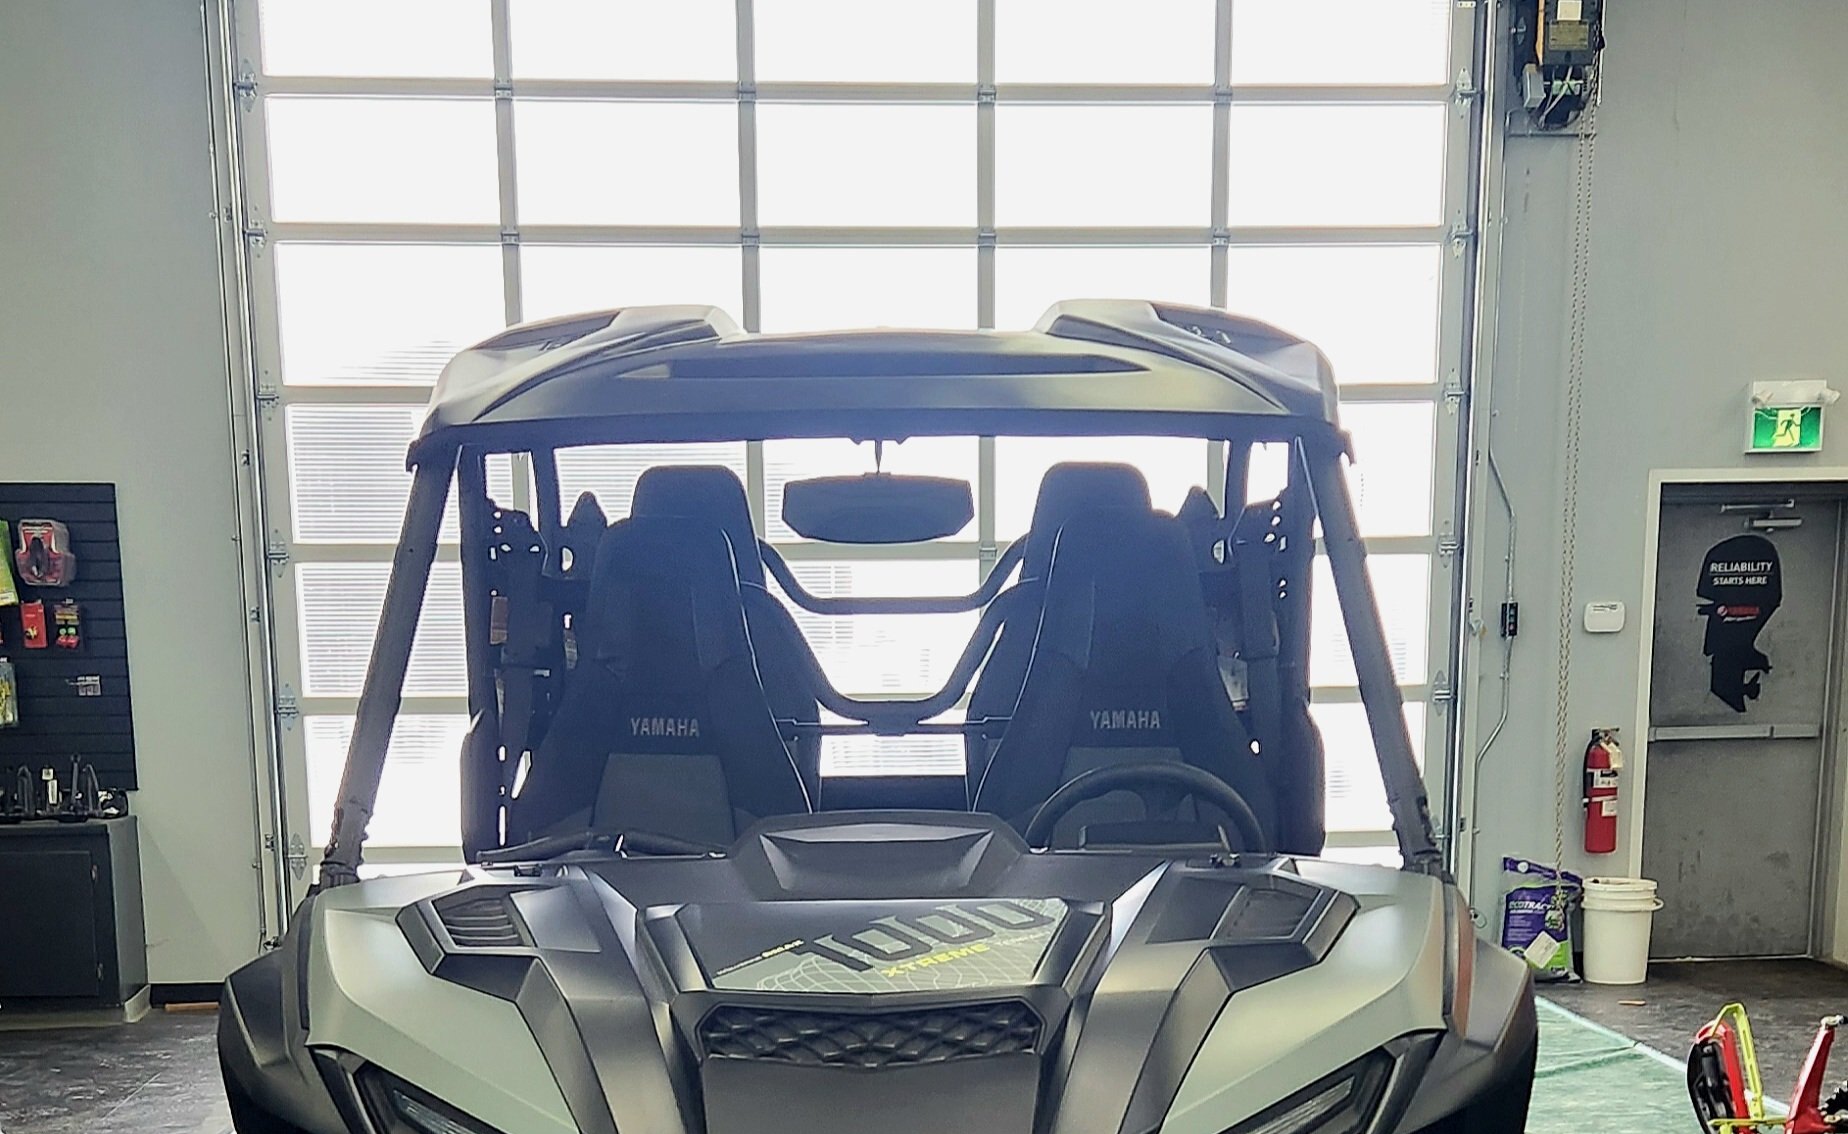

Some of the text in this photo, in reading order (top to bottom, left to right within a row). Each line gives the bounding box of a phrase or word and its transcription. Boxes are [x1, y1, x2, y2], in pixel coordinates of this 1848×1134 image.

[1710, 562, 1773, 572] RELIABILITY
[1713, 576, 1768, 586] STARTS HERE
[630, 717, 700, 737] YAMAHA
[1090, 710, 1161, 729] YAMAHA
[793, 900, 1056, 973] 1000
[881, 943, 991, 977] XTREME
